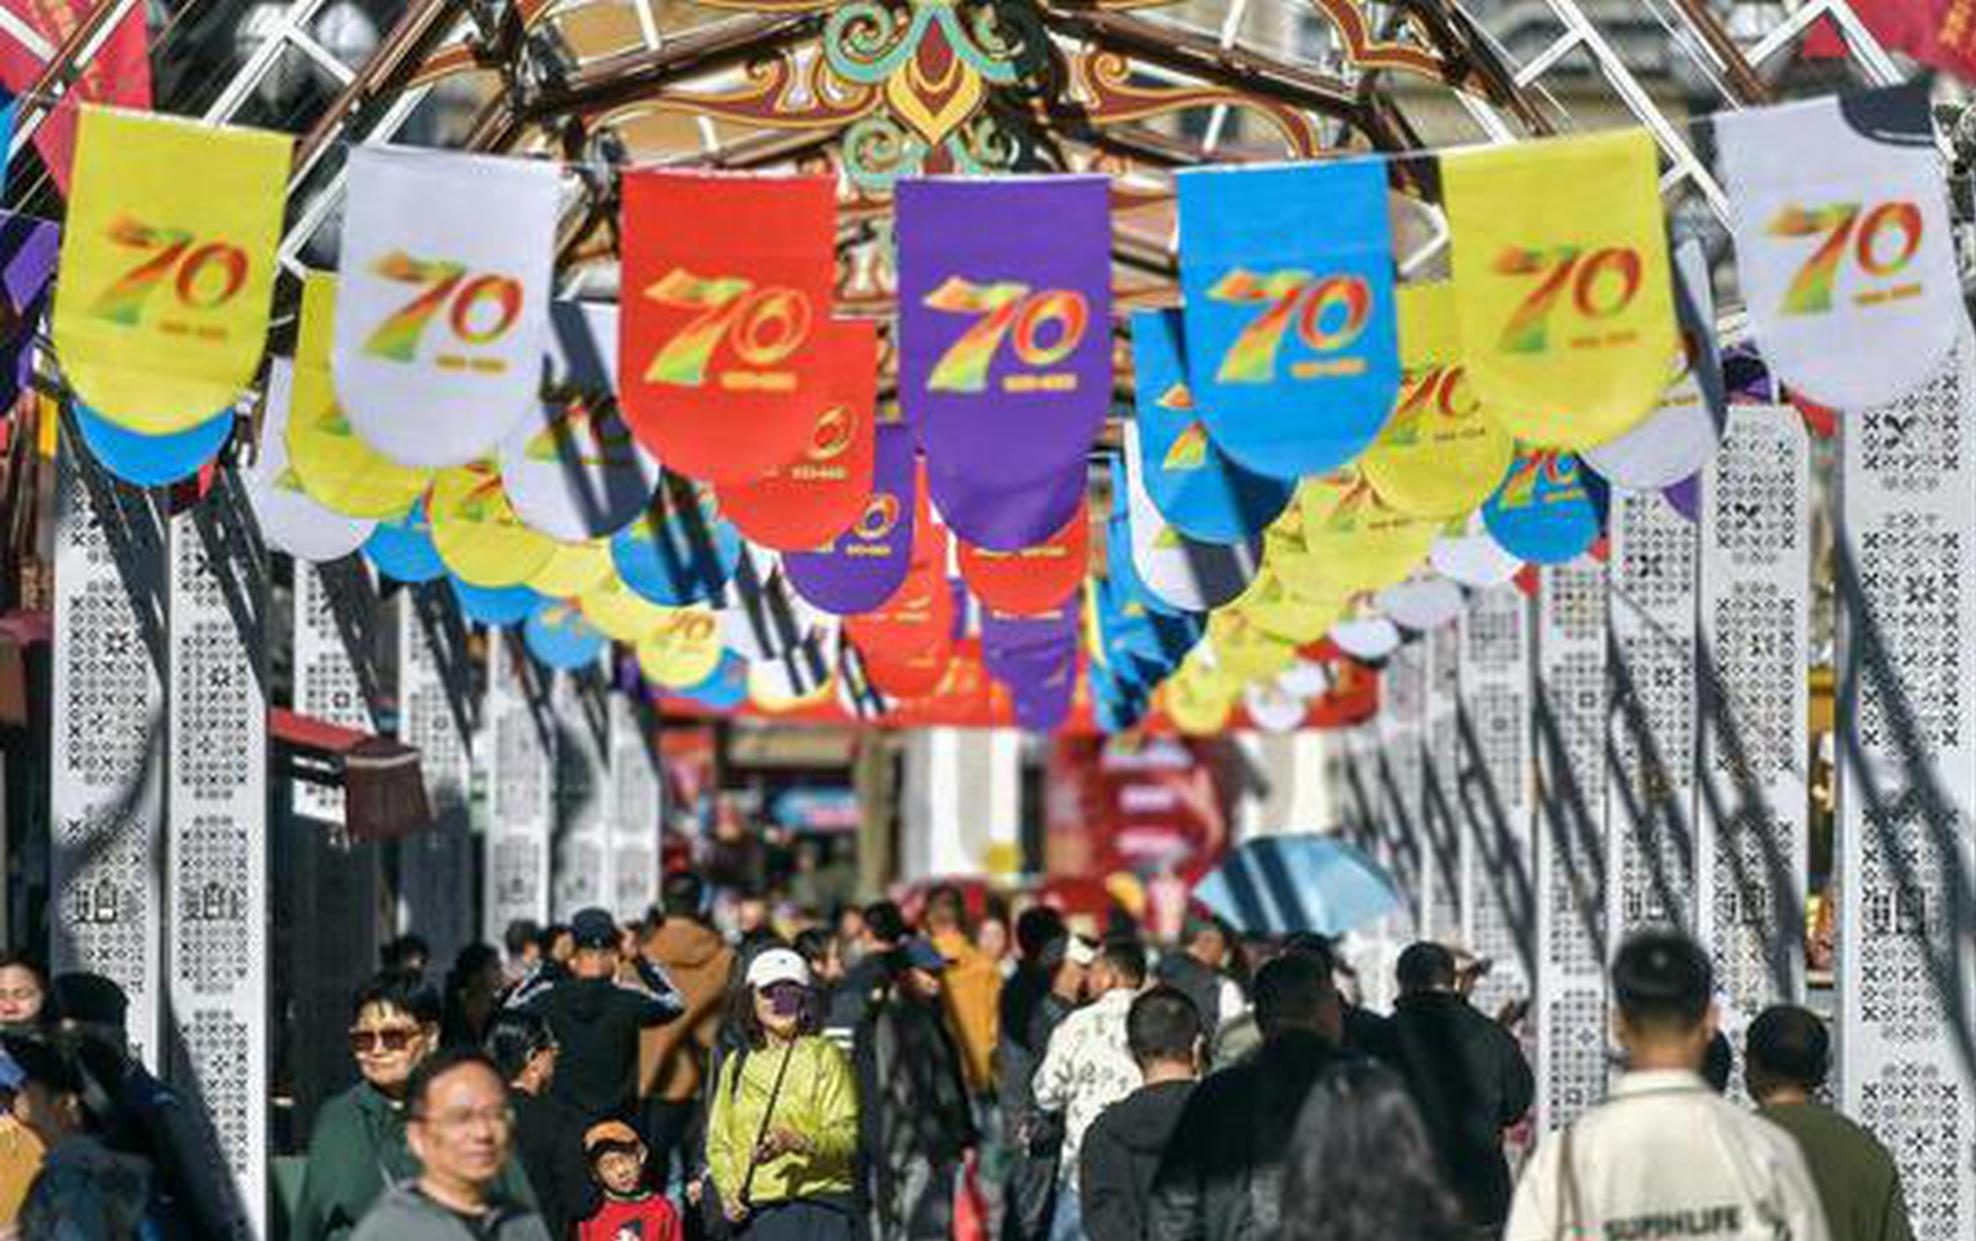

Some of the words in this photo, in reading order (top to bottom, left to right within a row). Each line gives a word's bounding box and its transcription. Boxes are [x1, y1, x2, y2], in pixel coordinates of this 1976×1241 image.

[90, 214, 247, 325] 70
[362, 251, 523, 364] 70
[1490, 246, 1642, 353] 70
[1764, 202, 1923, 314] 70
[642, 267, 812, 385] 70
[922, 275, 1088, 392] 70
[1205, 269, 1373, 384] 70
